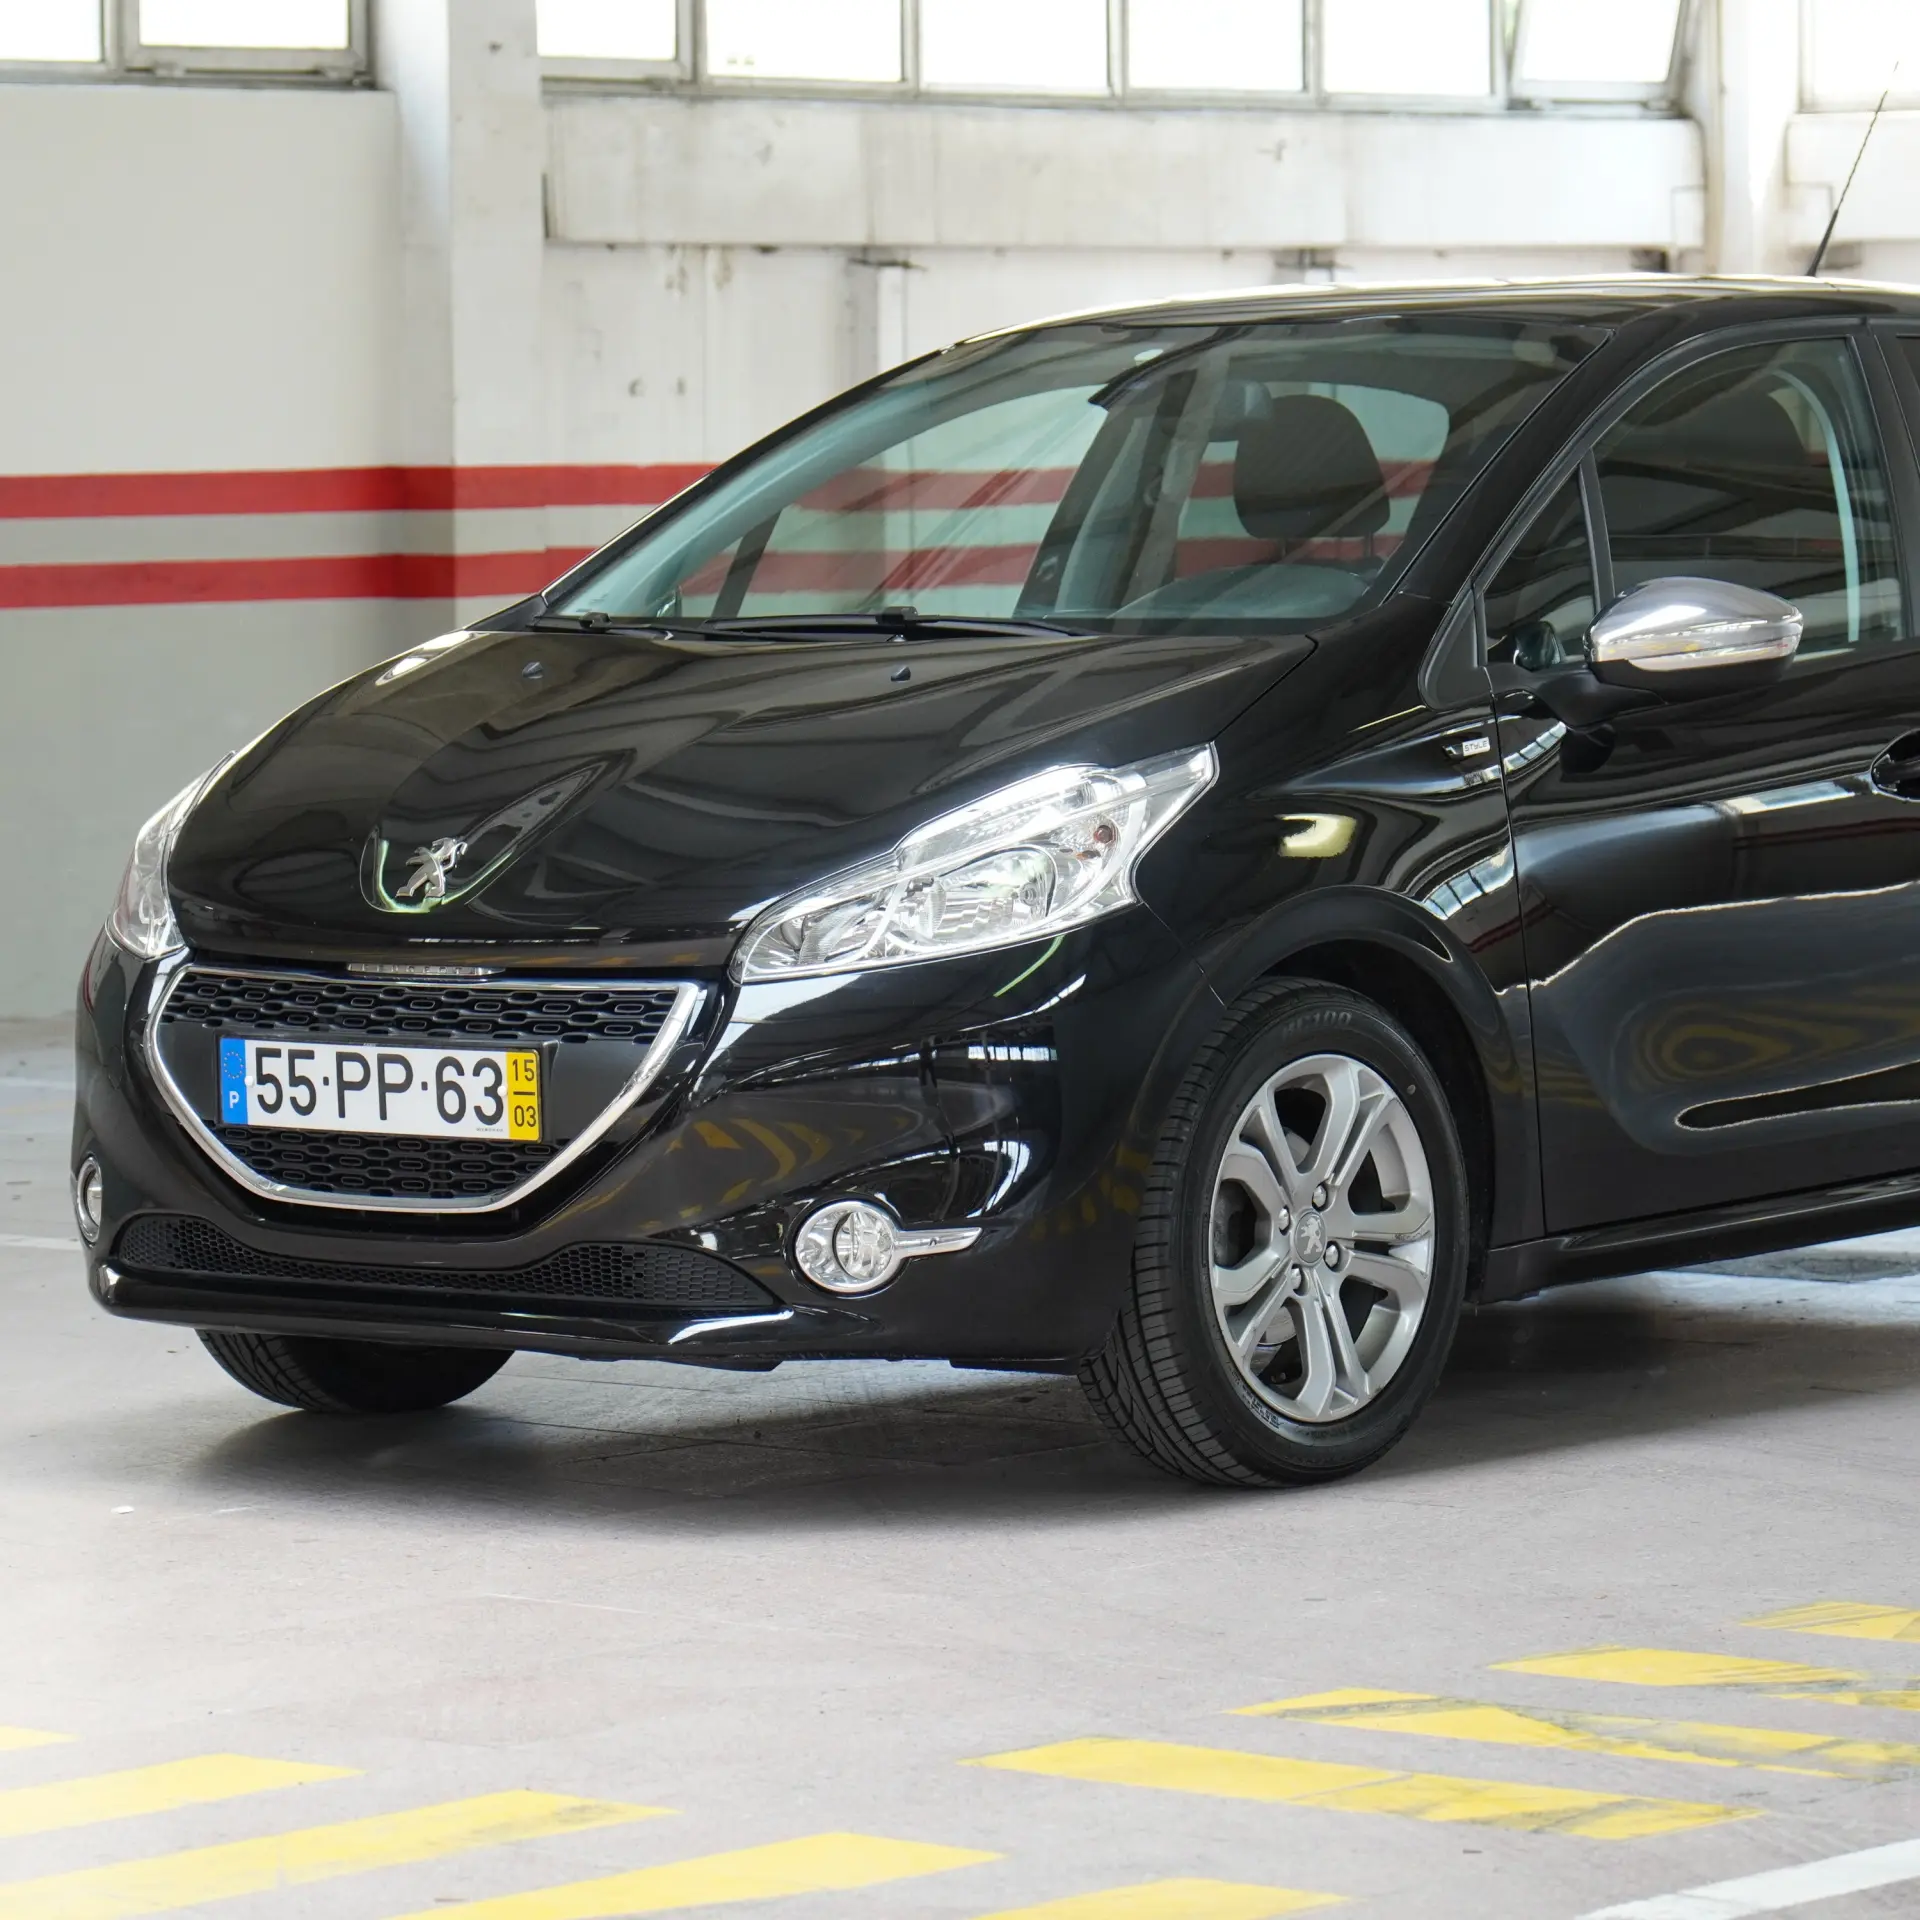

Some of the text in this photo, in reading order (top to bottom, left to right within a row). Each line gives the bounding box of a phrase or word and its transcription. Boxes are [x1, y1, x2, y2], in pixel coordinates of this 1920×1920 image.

[1464, 740, 1488, 752] STYLE
[512, 1058, 534, 1082] 15
[229, 1090, 240, 1109] P
[514, 1105, 537, 1128] 03
